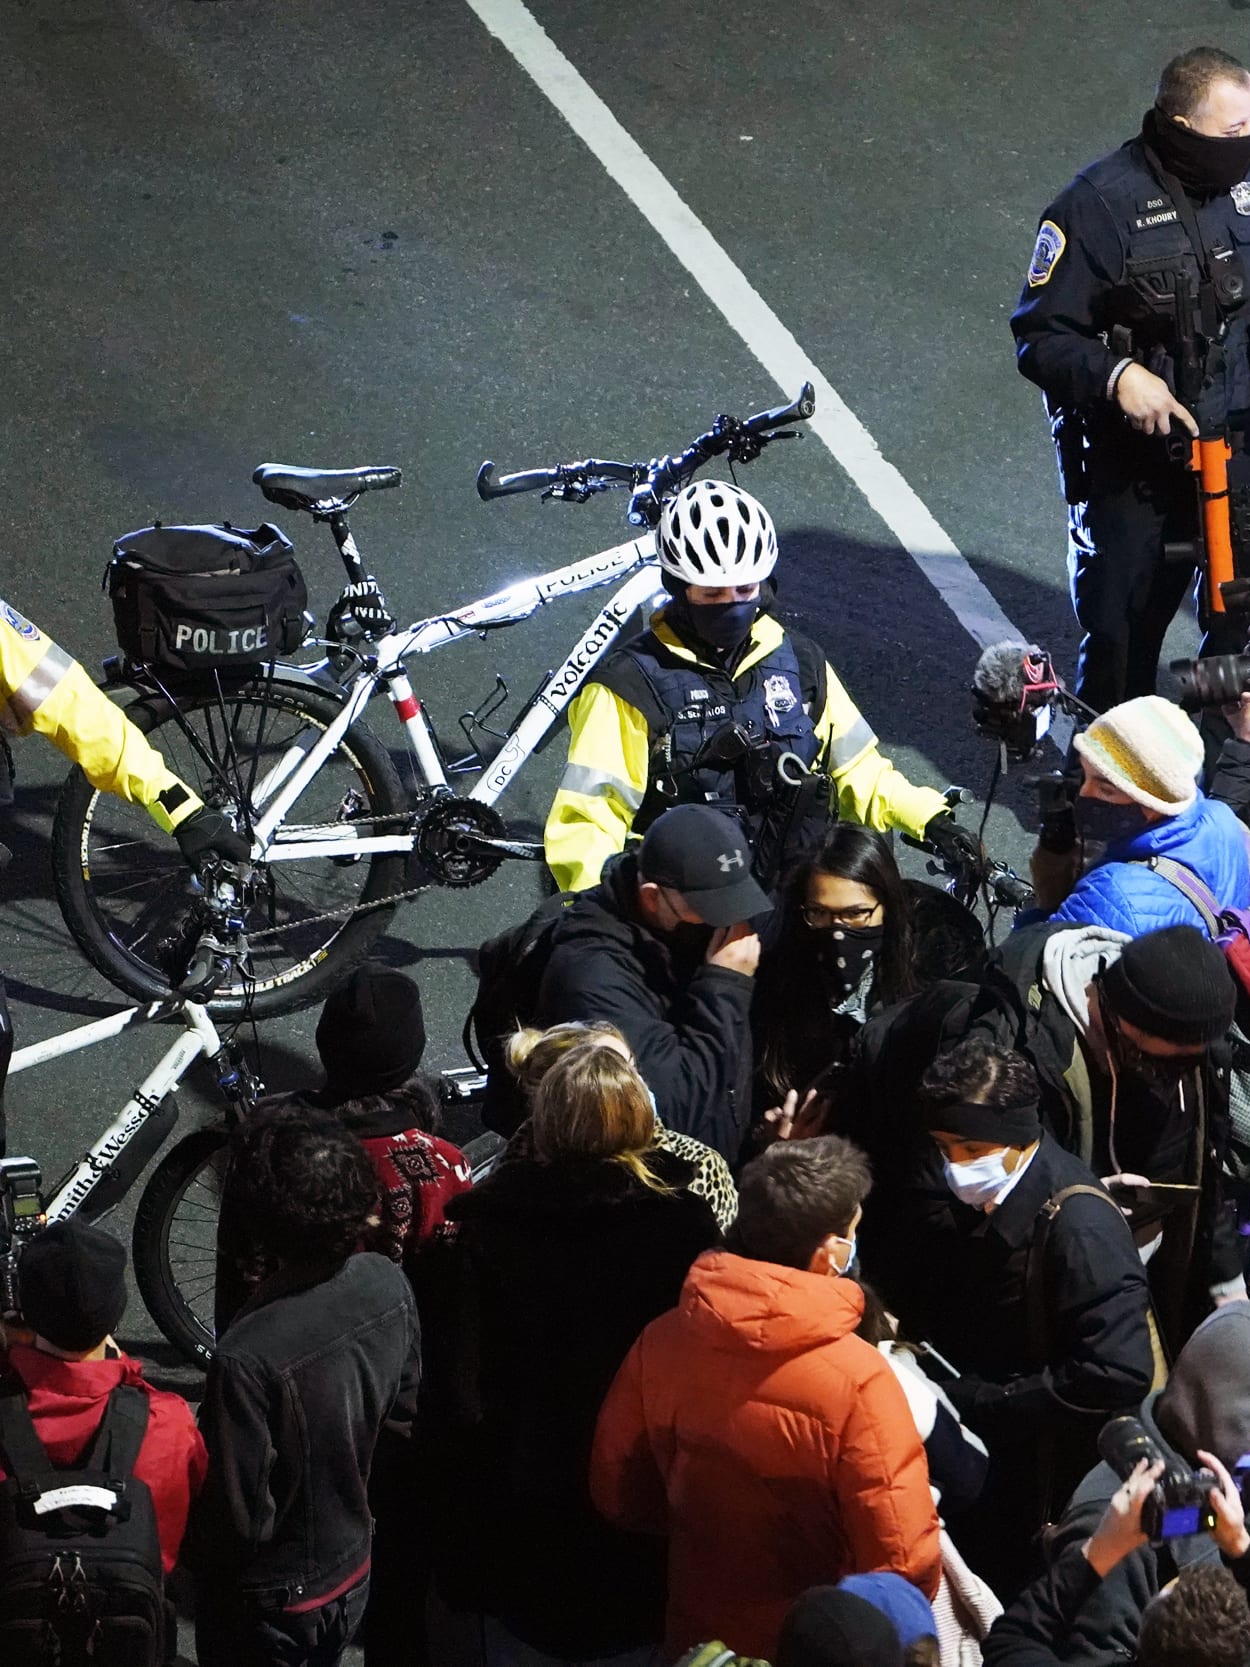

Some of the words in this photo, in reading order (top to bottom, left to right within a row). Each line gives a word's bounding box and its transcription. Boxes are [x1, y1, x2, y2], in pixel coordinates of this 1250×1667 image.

[1147, 198, 1163, 209] DSO
[1136, 217, 1145, 228] R.
[1146, 210, 1178, 226] KHOURY
[175, 624, 268, 654] POLICE
[550, 601, 628, 698] volcanic
[495, 765, 512, 786] DC
